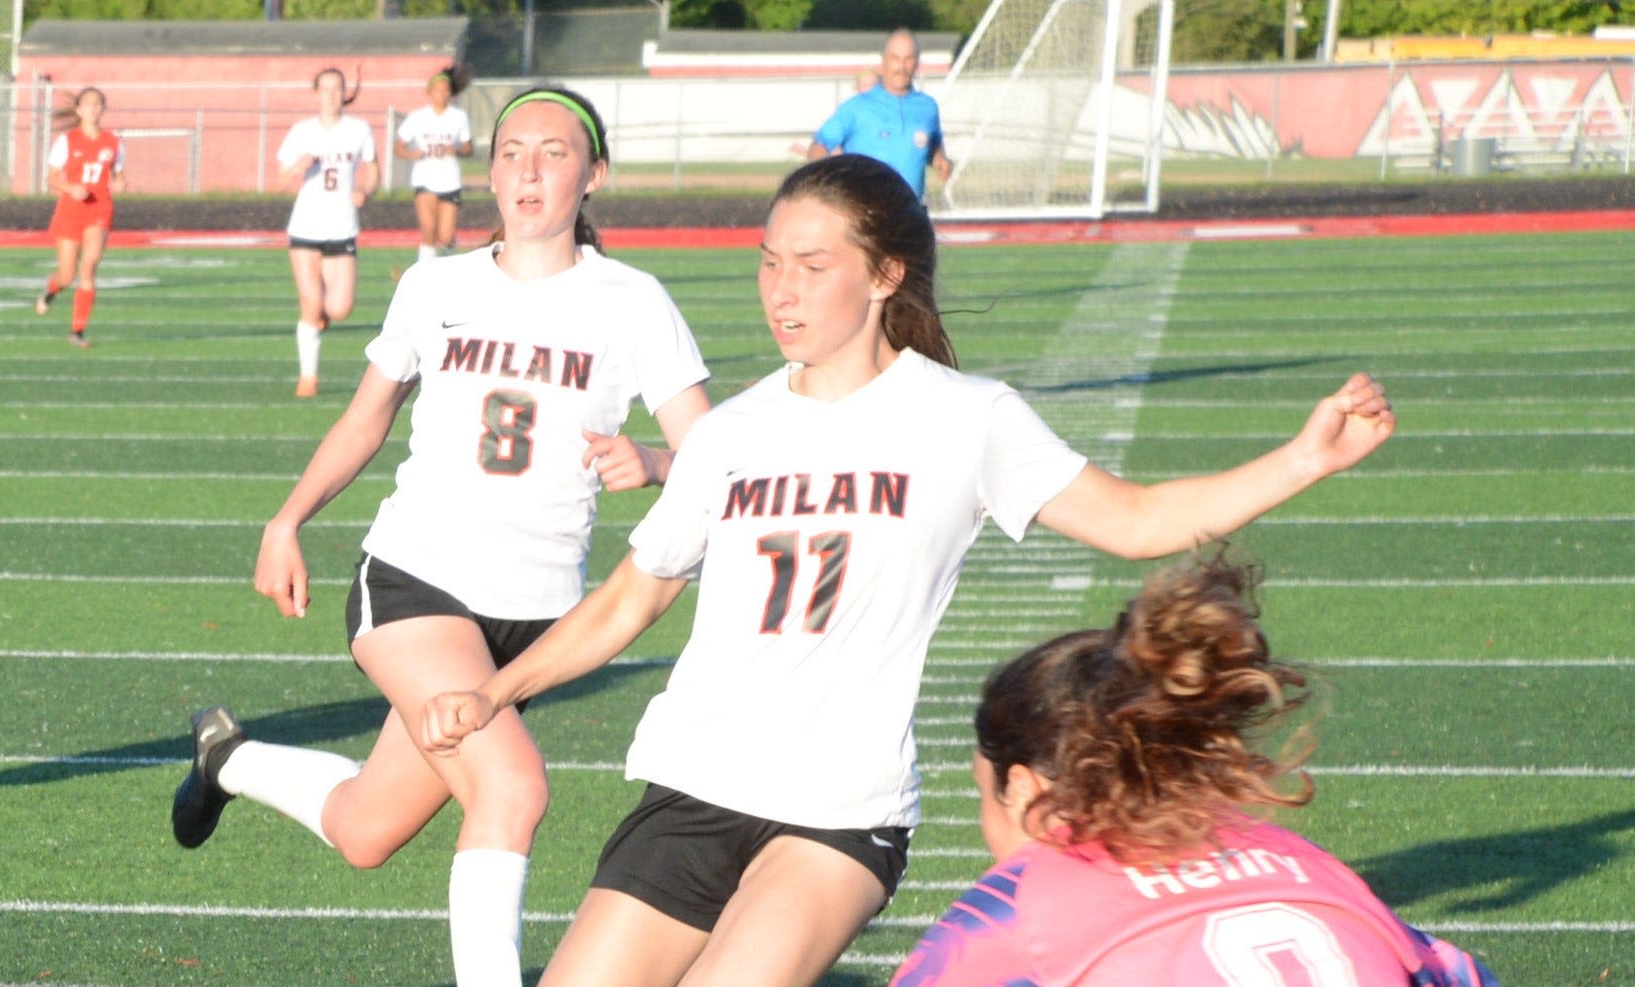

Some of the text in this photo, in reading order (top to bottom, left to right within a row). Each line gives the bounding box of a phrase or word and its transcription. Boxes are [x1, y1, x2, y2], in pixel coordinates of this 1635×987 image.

[324, 168, 339, 191] 6
[439, 337, 595, 391] MILAN
[477, 388, 538, 477] 8
[720, 471, 910, 521] MILAN
[756, 530, 852, 635] 11
[1122, 848, 1311, 899] Henry
